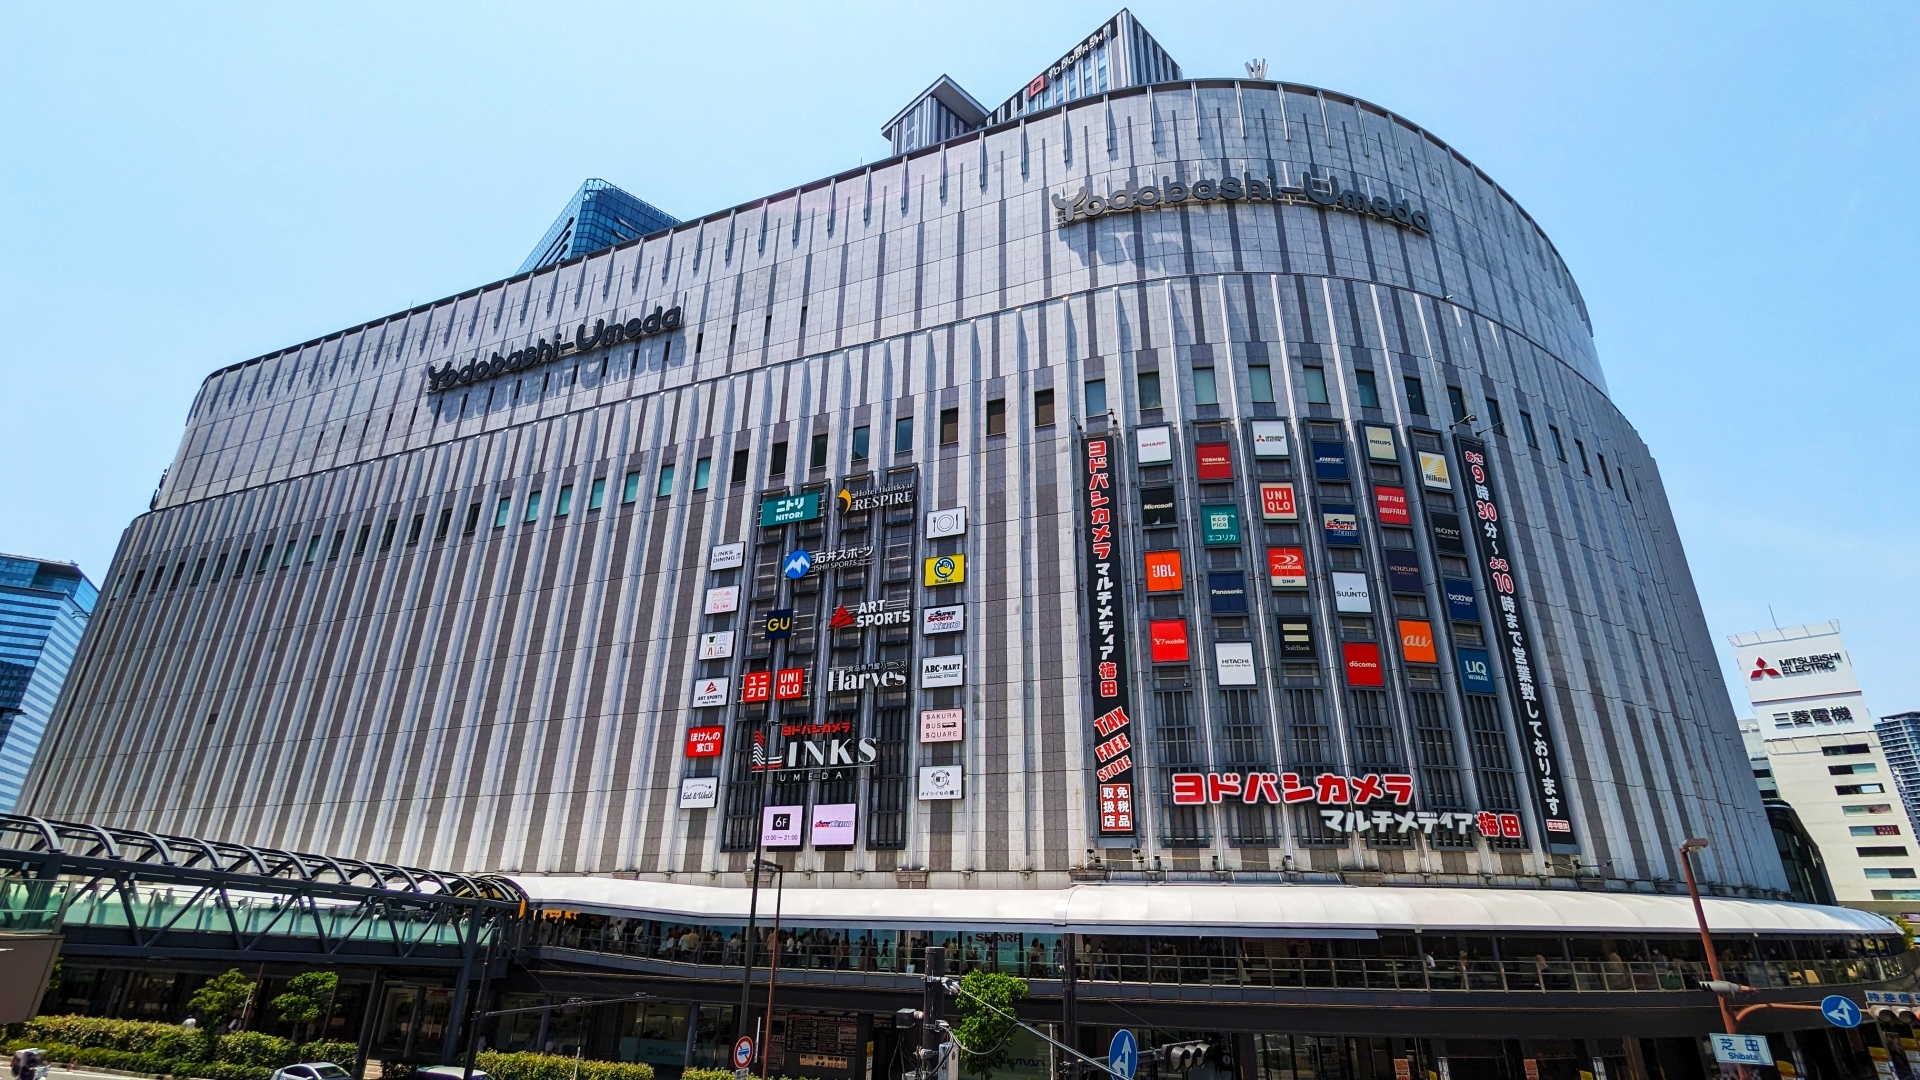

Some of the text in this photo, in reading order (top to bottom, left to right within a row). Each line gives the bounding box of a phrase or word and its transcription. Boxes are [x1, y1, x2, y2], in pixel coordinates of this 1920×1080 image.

[1052, 171, 1431, 235] Yodobashi-Umeda
[428, 305, 682, 391] Yodobashi-Umeda
[1425, 474, 1448, 484] Nikon
[856, 482, 914, 498] Hotel Hankyu
[1265, 490, 1288, 500] UNI
[776, 497, 805, 513] ニトリ
[855, 491, 914, 511] RESPIRE
[1377, 494, 1404, 503] BUFFALO
[1143, 502, 1174, 510] Microsoft
[1267, 501, 1291, 512] QLO
[775, 511, 803, 522] NITORI
[1207, 533, 1236, 541] エコリカ
[1434, 527, 1459, 536] SONY
[712, 555, 735, 563] DINING
[713, 550, 734, 558] LINKS
[814, 546, 874, 564] 石井スポーツ
[813, 560, 857, 572] ISHII SPORTS
[1151, 564, 1176, 578] JBL
[1336, 590, 1368, 598] SUUNTO
[1448, 592, 1474, 603] brother
[857, 600, 886, 614] ART
[767, 617, 790, 632] GU
[856, 610, 911, 628] SPORTS
[1403, 634, 1431, 648] au
[1778, 652, 1842, 666] MITSUBISHI
[924, 663, 961, 673] ABC-MART
[1465, 660, 1487, 676] UQ
[1781, 660, 1837, 675] ELECTRIC
[749, 675, 767, 687] ユニ
[780, 672, 799, 684] UNI
[827, 670, 907, 692] Harves
[747, 687, 767, 698] クロ
[779, 684, 800, 697] QLO
[1094, 706, 1130, 737] TAX
[1772, 705, 1853, 727] 三菱電機
[690, 731, 721, 742] ほけんの
[782, 722, 853, 737] ヨドバシカメラ
[925, 731, 958, 739] SQUARE
[751, 730, 878, 771] LINKS
[1095, 732, 1131, 762] FREE
[1097, 755, 1132, 782] STORE
[779, 771, 843, 782] UMEDA
[1171, 772, 1415, 806] ヨドバシカメラ
[775, 816, 788, 827] 6F
[1320, 809, 1523, 839] マルチメディア梅田
[1719, 1037, 1761, 1052] 芝田
[1728, 1051, 1759, 1061] Shibata
